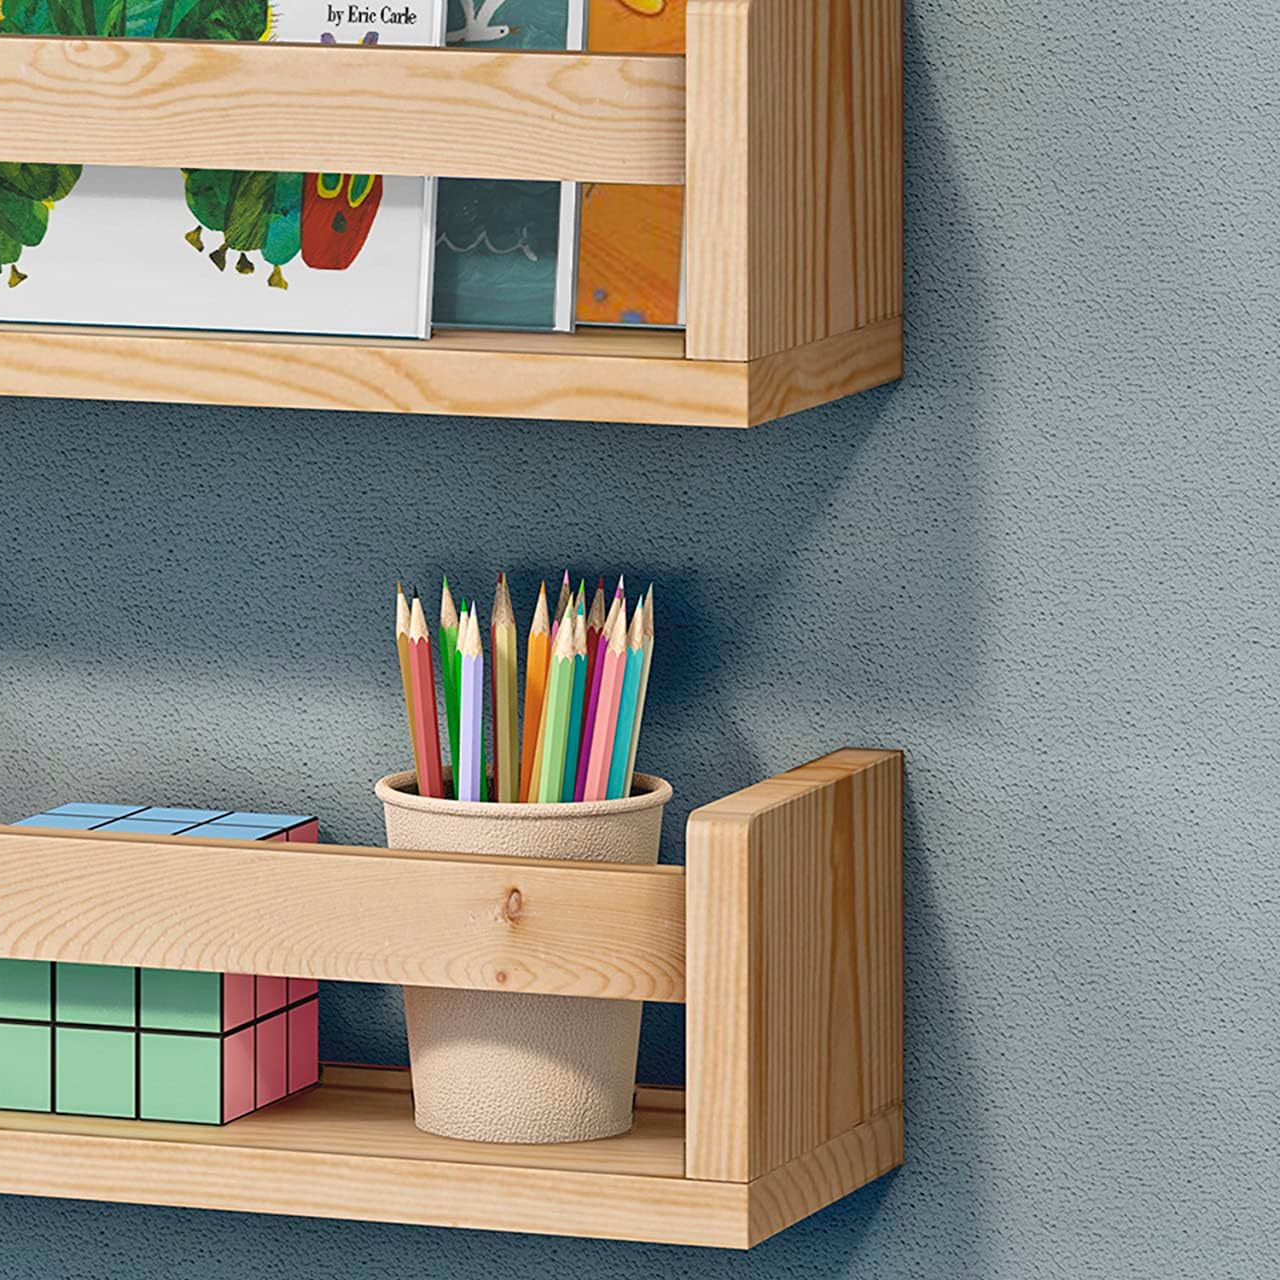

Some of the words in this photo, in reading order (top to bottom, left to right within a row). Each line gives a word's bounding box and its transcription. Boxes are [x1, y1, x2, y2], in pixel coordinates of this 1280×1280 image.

[327, 4, 345, 26] by
[347, 4, 377, 24] Eric
[380, 6, 417, 25] Carle
